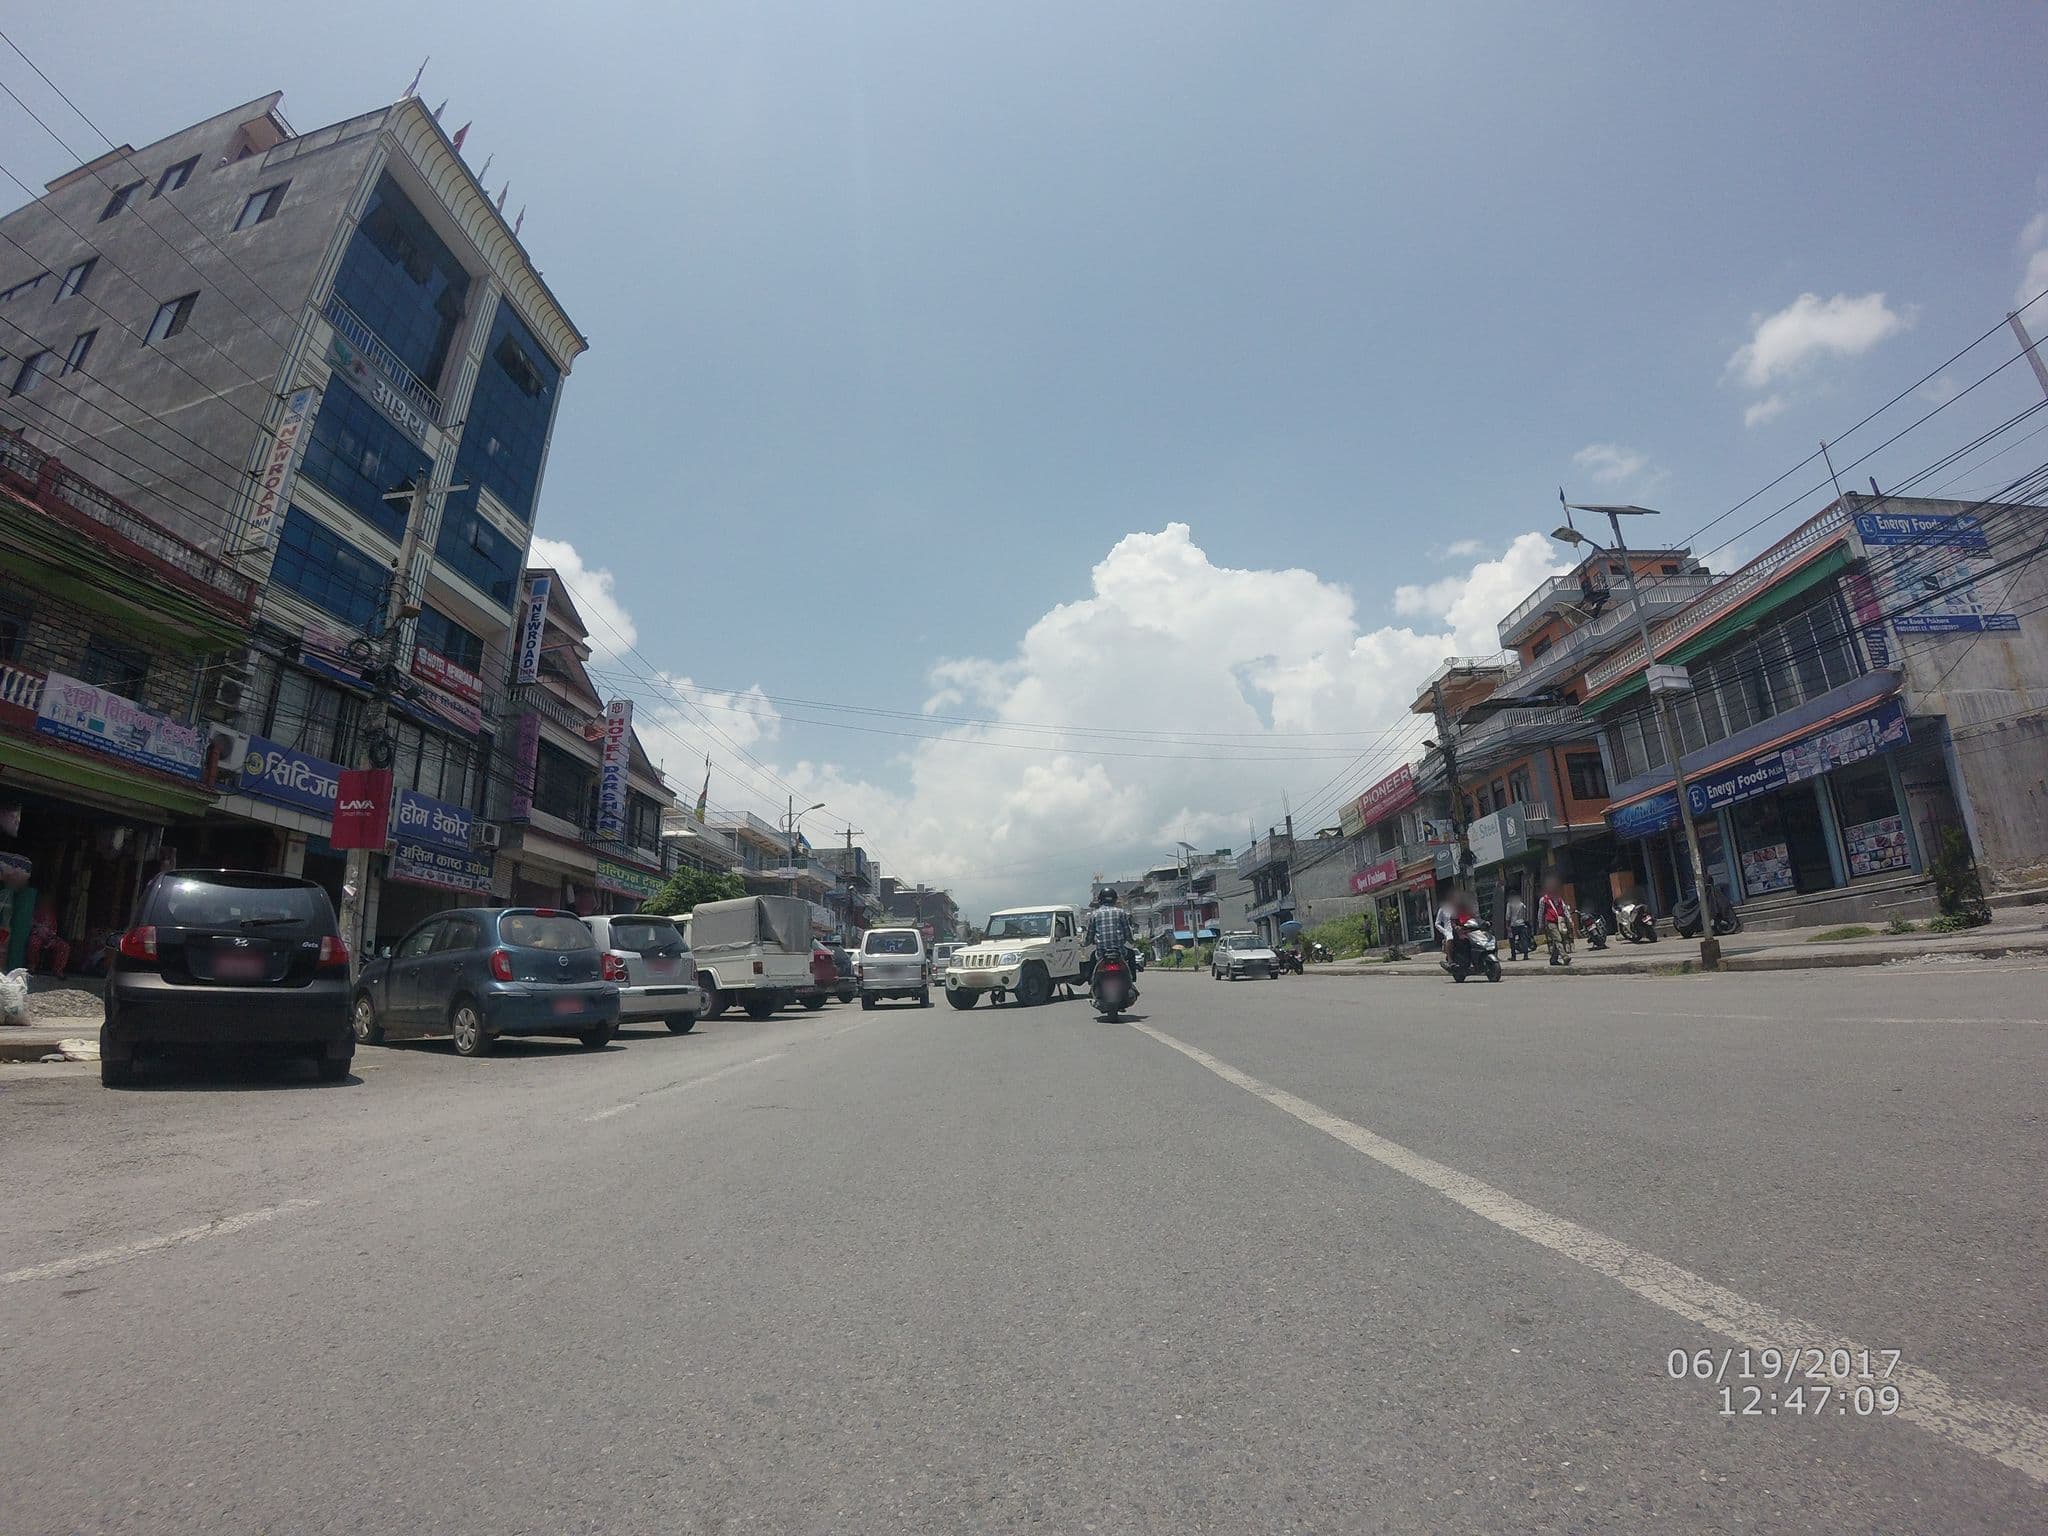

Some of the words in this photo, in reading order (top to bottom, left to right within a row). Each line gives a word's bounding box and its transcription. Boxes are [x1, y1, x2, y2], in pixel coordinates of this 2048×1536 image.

[256, 425, 297, 517] NEWROAD
[250, 516, 272, 530] INN
[1875, 516, 1911, 534] Energy
[523, 603, 542, 668] NEWROAD
[606, 718, 625, 761] HOTEL
[601, 766, 620, 829] DARSHAN
[1362, 768, 1412, 809] PIONEER
[1706, 778, 1736, 800] Energy
[1737, 767, 1768, 789] Foods
[340, 799, 375, 810] LAVA
[401, 799, 430, 828] होम
[432, 808, 470, 840] डेकोर
[400, 844, 434, 865] असिम
